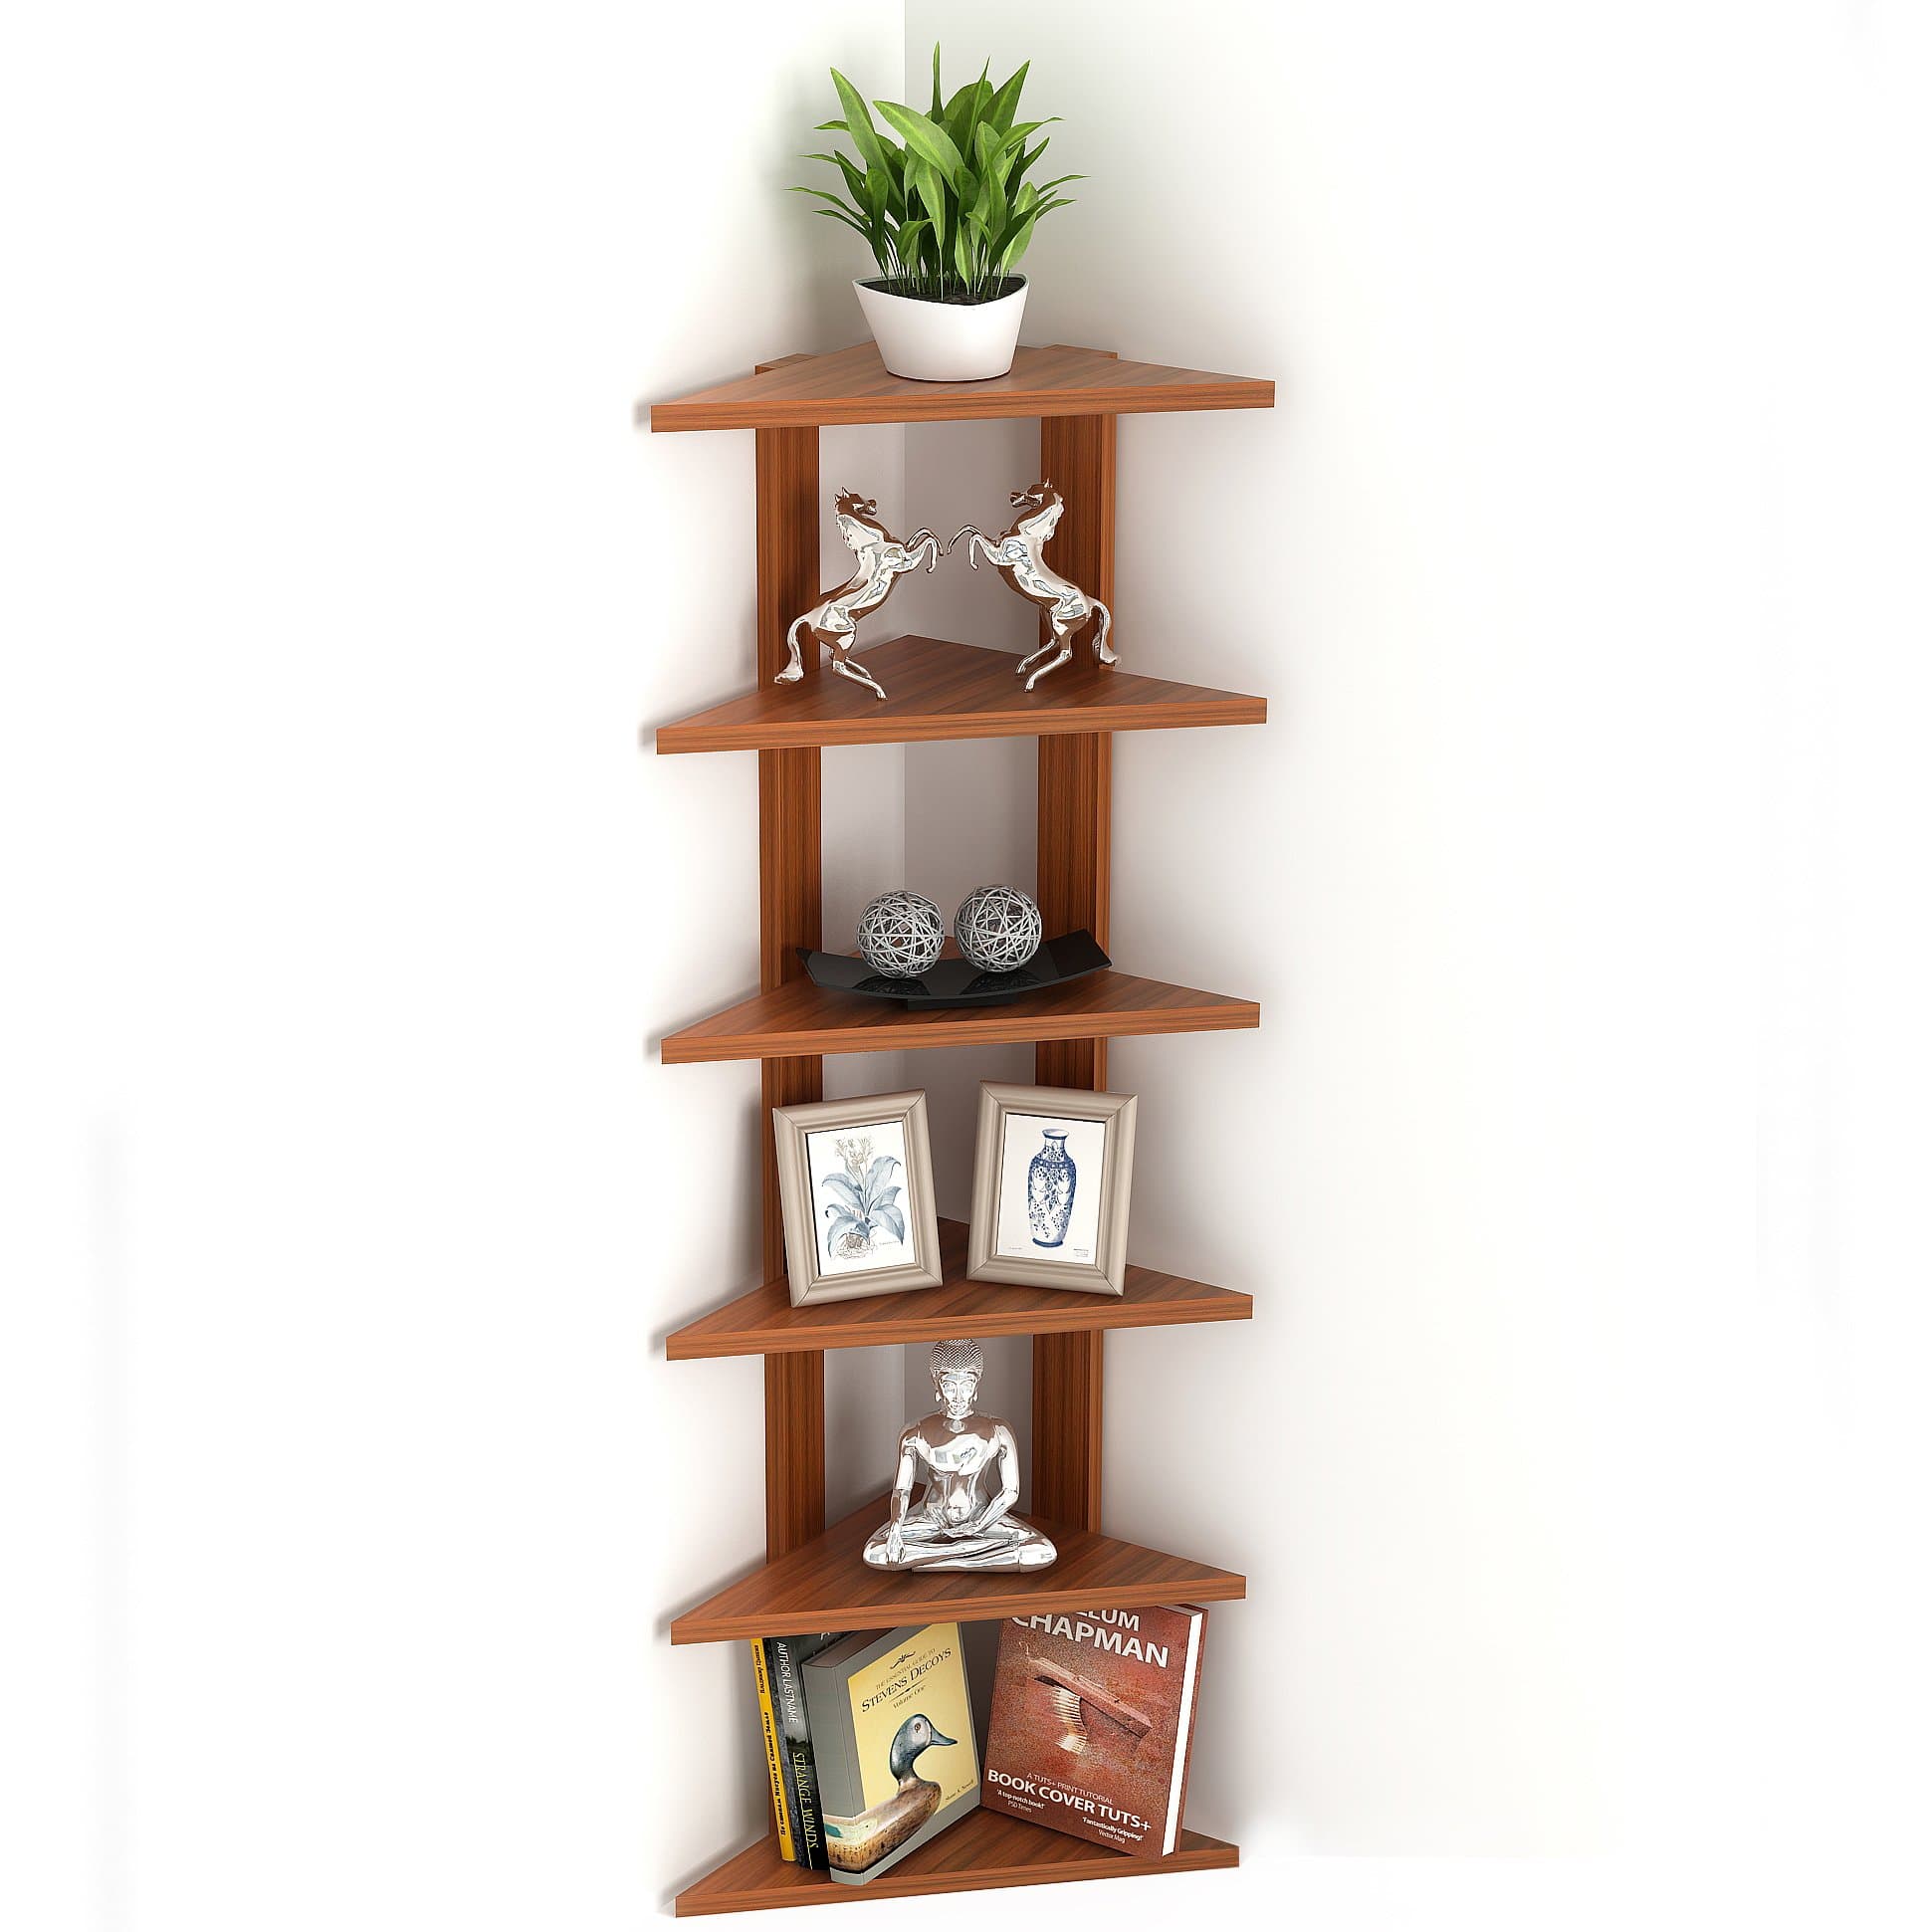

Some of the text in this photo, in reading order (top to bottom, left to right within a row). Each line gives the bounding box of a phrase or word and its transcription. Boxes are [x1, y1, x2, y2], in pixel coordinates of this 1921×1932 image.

[776, 1641, 798, 1723] AUTHOR LASTNAME
[861, 1647, 952, 1712] STEVENS DECOYS
[793, 1752, 819, 1848] STRANGE WINDS
[987, 1769, 1037, 1796] BOOK
[1038, 1786, 1095, 1815] COVER
[1097, 1804, 1152, 1831] TUTS+
[1034, 1774, 1056, 1787] TUTS+
[1057, 1782, 1078, 1794] PRINT
[1078, 1788, 1114, 1806] TUTORIAL
